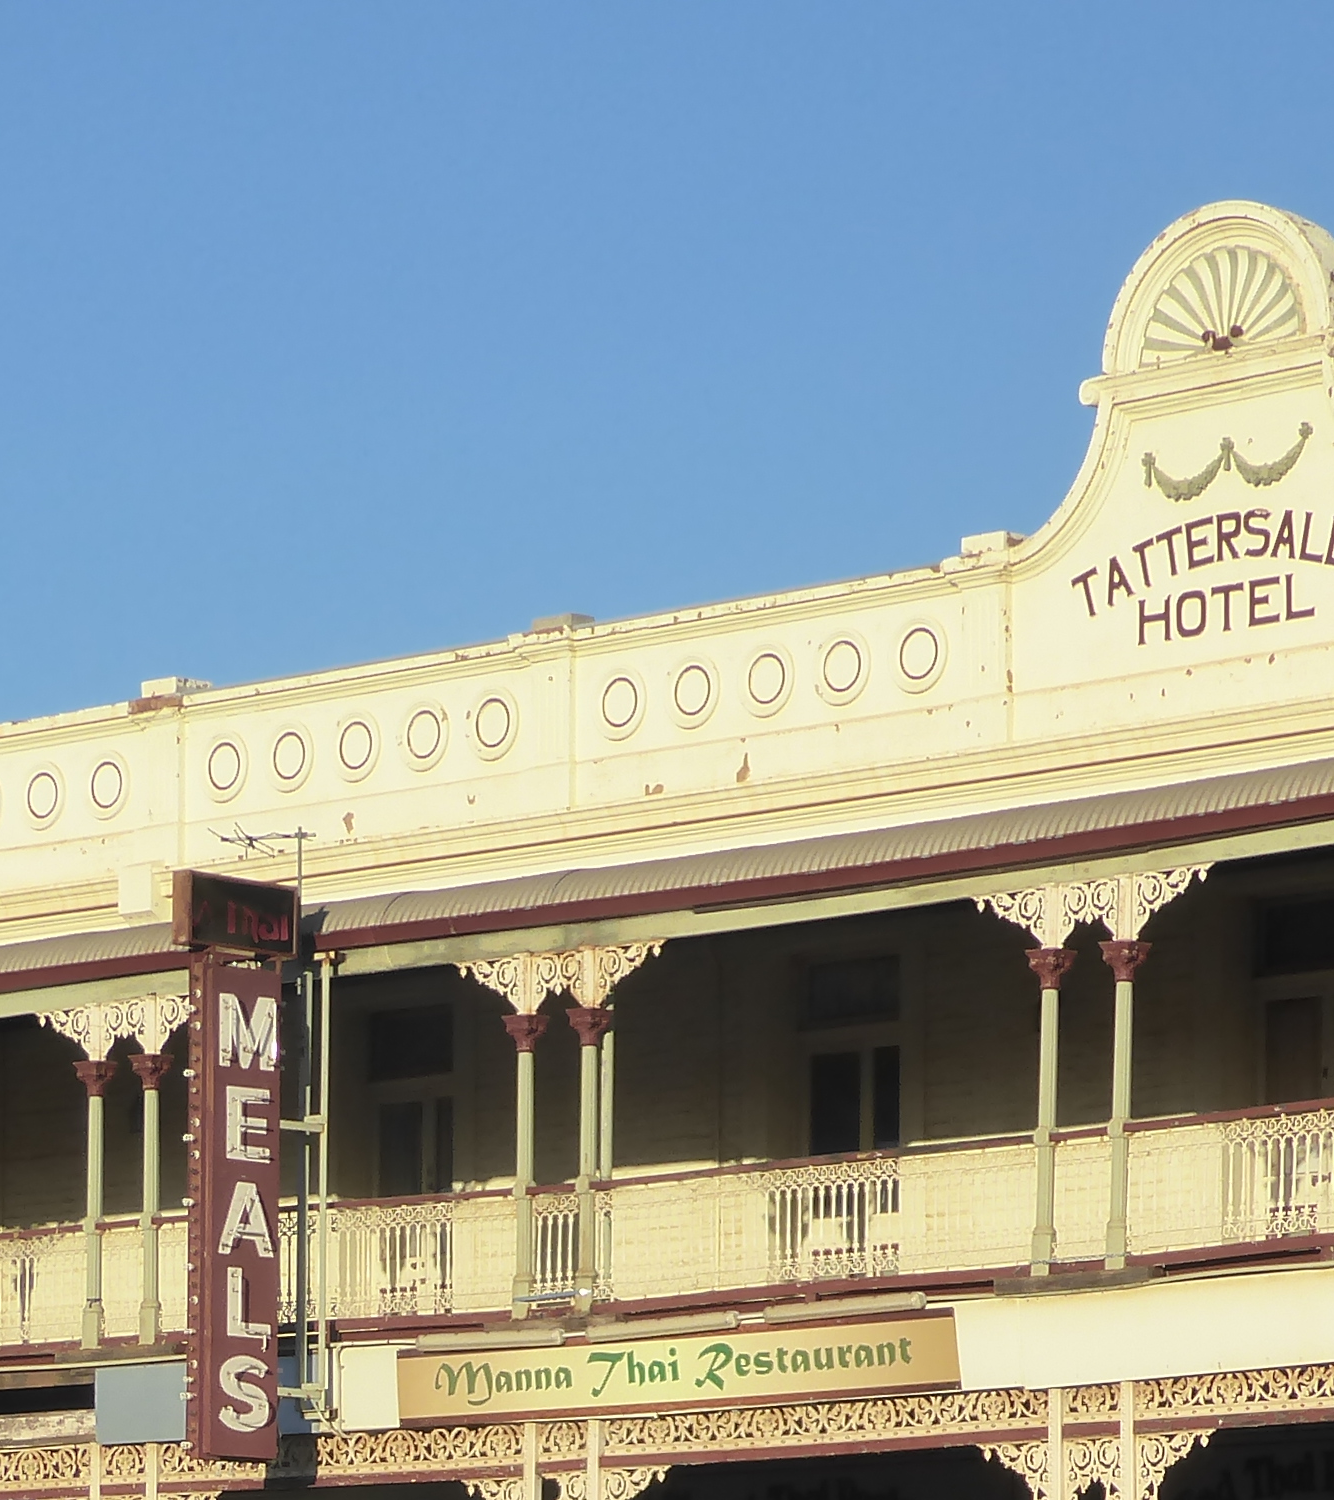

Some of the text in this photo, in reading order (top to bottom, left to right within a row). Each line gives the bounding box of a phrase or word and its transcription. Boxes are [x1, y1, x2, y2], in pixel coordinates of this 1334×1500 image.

[1137, 573, 1316, 646] HOTEL
[218, 992, 278, 1433] MEALS
[434, 1336, 914, 1406] Manna Thai Restaurant
